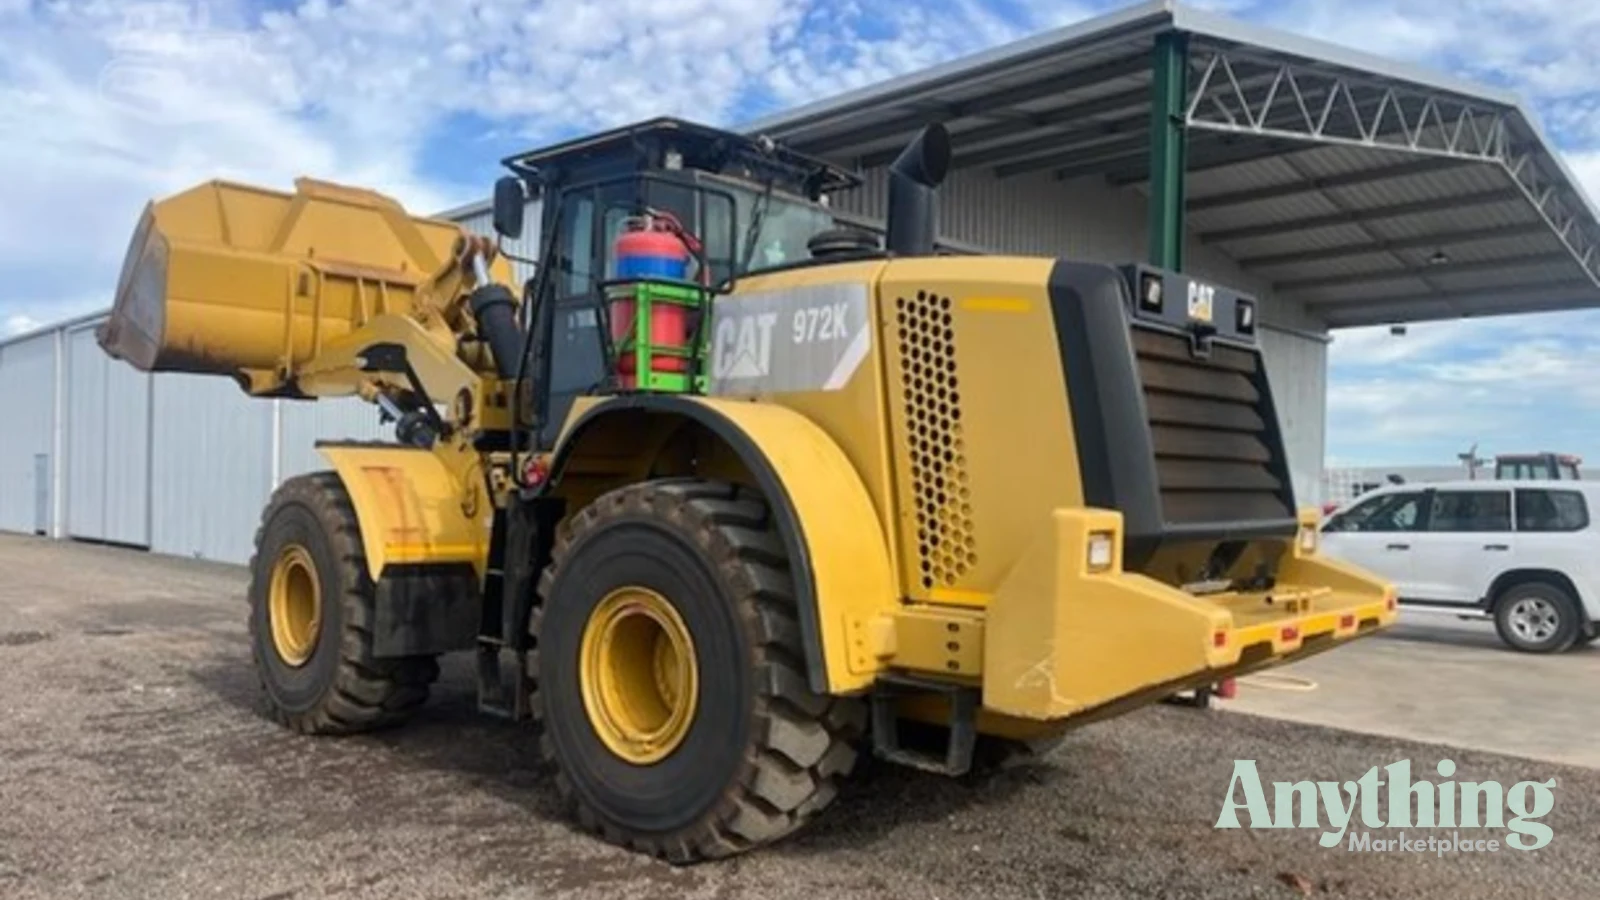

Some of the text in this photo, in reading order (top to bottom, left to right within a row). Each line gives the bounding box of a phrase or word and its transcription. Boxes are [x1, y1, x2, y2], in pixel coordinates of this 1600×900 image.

[1188, 281, 1215, 321] CAT
[714, 303, 848, 378] CAT 972K
